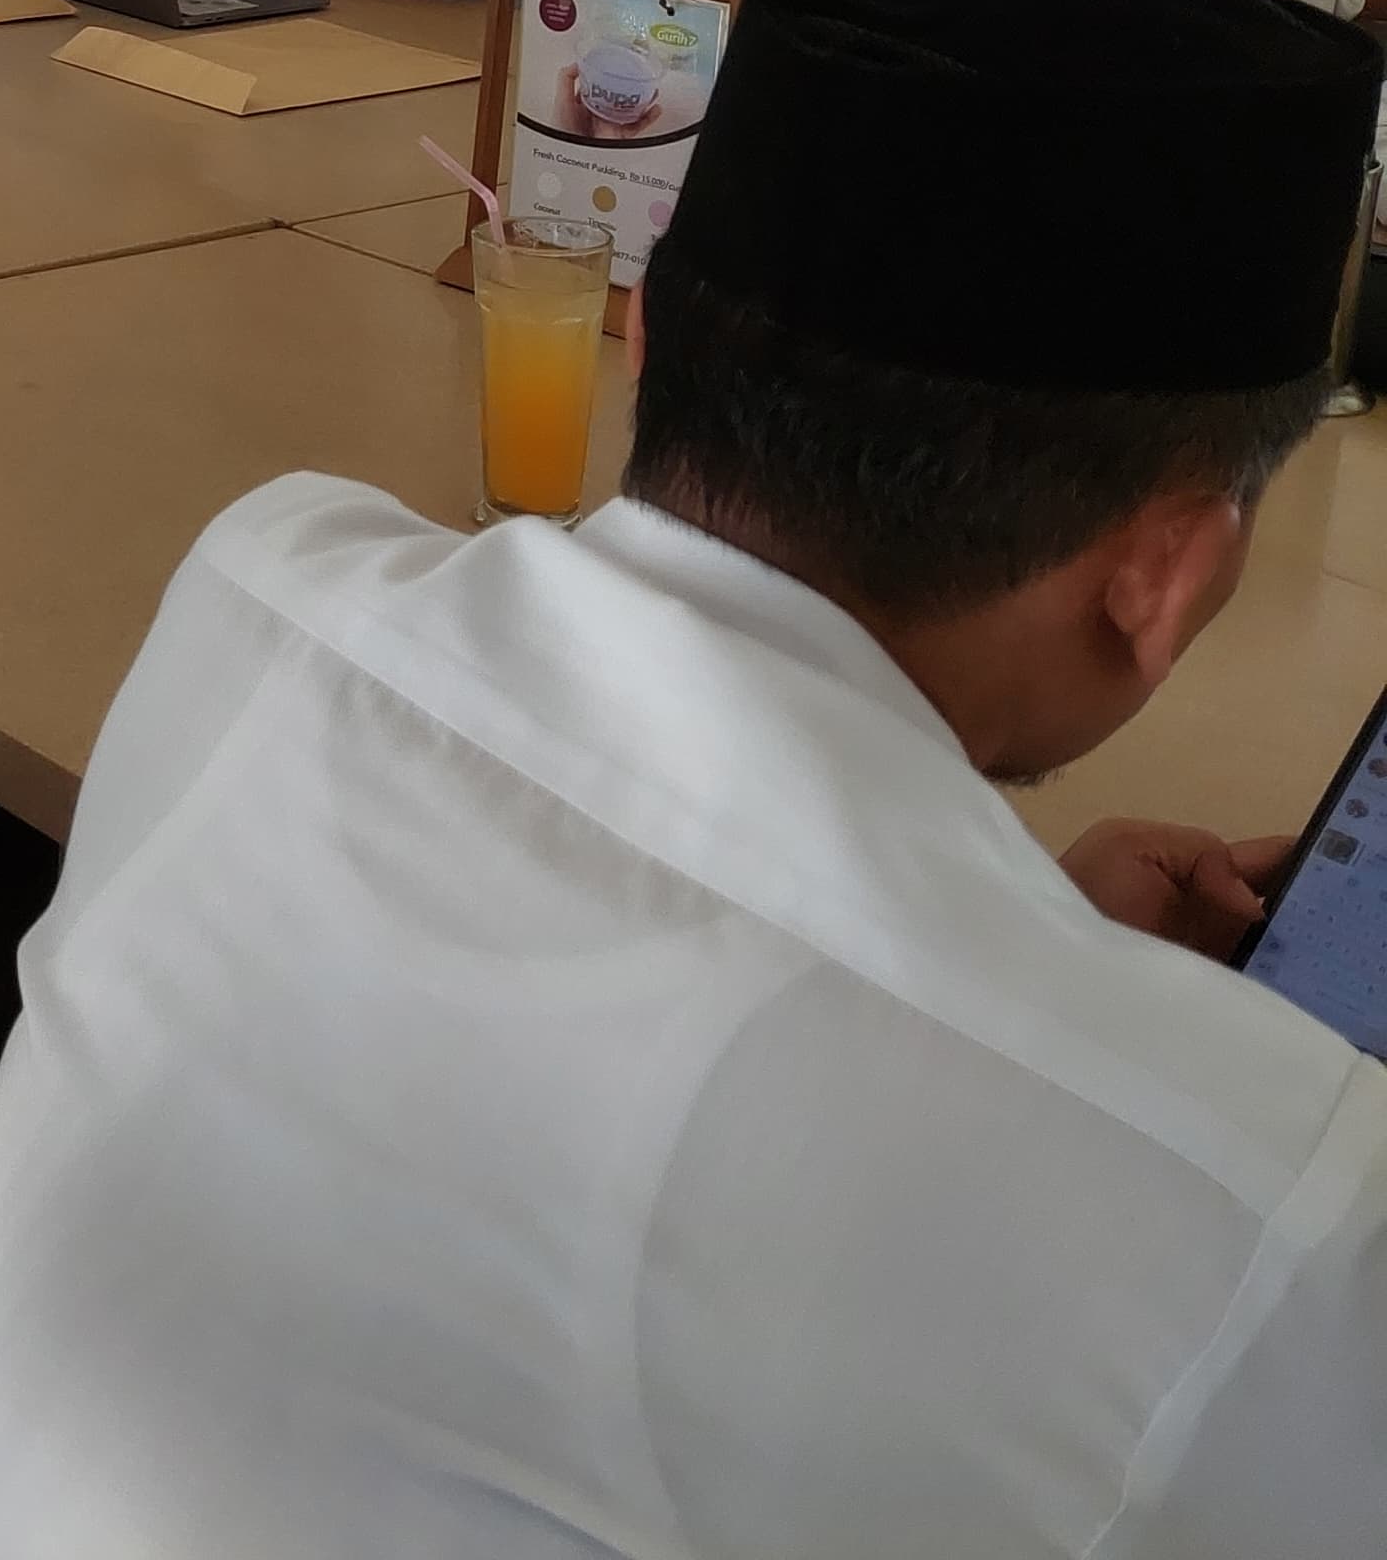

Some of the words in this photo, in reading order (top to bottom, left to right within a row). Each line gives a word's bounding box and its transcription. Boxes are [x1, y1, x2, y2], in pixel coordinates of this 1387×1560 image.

[533, 148, 555, 161] Fresh
[556, 154, 590, 169] Coconut
[533, 202, 561, 216] Coconut
